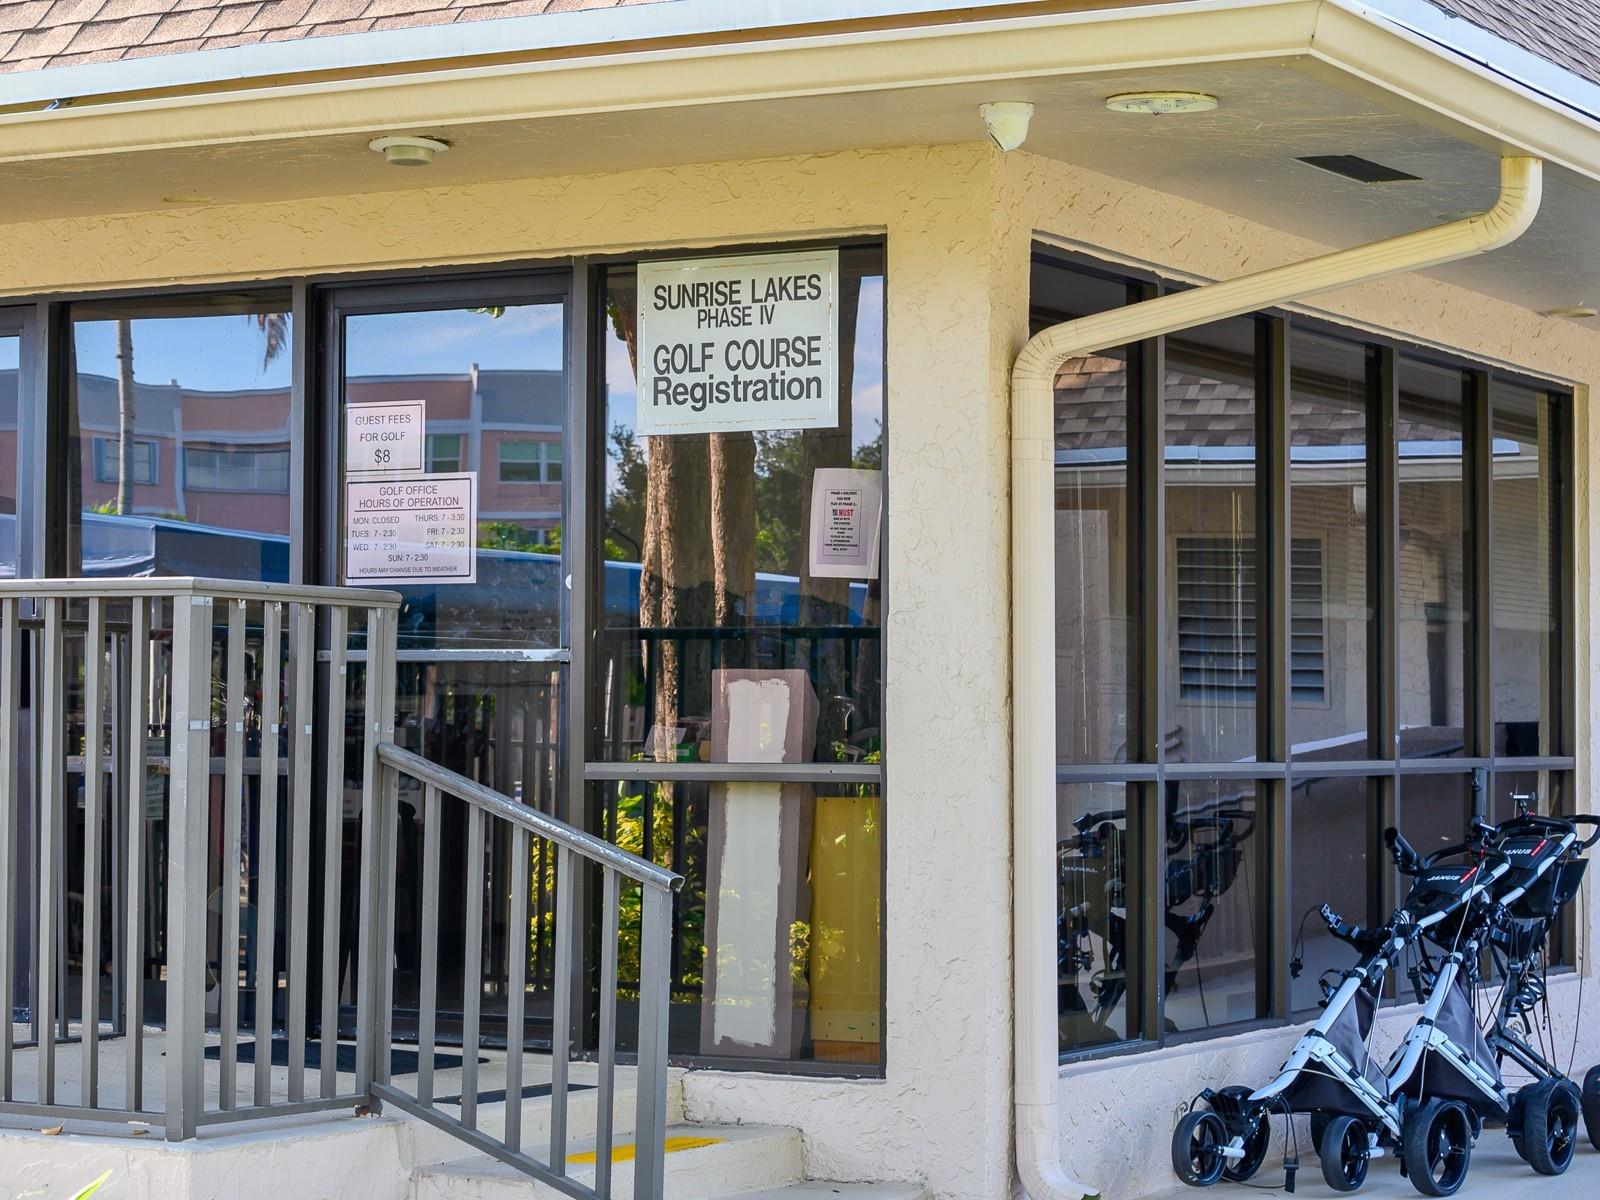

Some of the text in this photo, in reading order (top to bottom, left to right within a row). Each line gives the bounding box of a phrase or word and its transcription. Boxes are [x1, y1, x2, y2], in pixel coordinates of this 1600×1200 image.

[653, 273, 822, 311] SUNRISE LAKES
[697, 304, 776, 329] PHASE IV
[653, 336, 822, 375] GOLF COURSE
[653, 370, 822, 412] Registration
[355, 414, 411, 426] GUEST FEES
[360, 431, 406, 442] FOR GOLF
[374, 448, 391, 466] $8
[379, 485, 438, 496] GOLF OFFICE
[359, 496, 459, 509] HOURS OF OPERATION
[441, 513, 446, 521] 7
[838, 508, 854, 517] MUST
[371, 516, 400, 525] CLOSED
[374, 529, 378, 537] 7
[441, 527, 446, 535] 7
[432, 565, 457, 573] WEATHER
